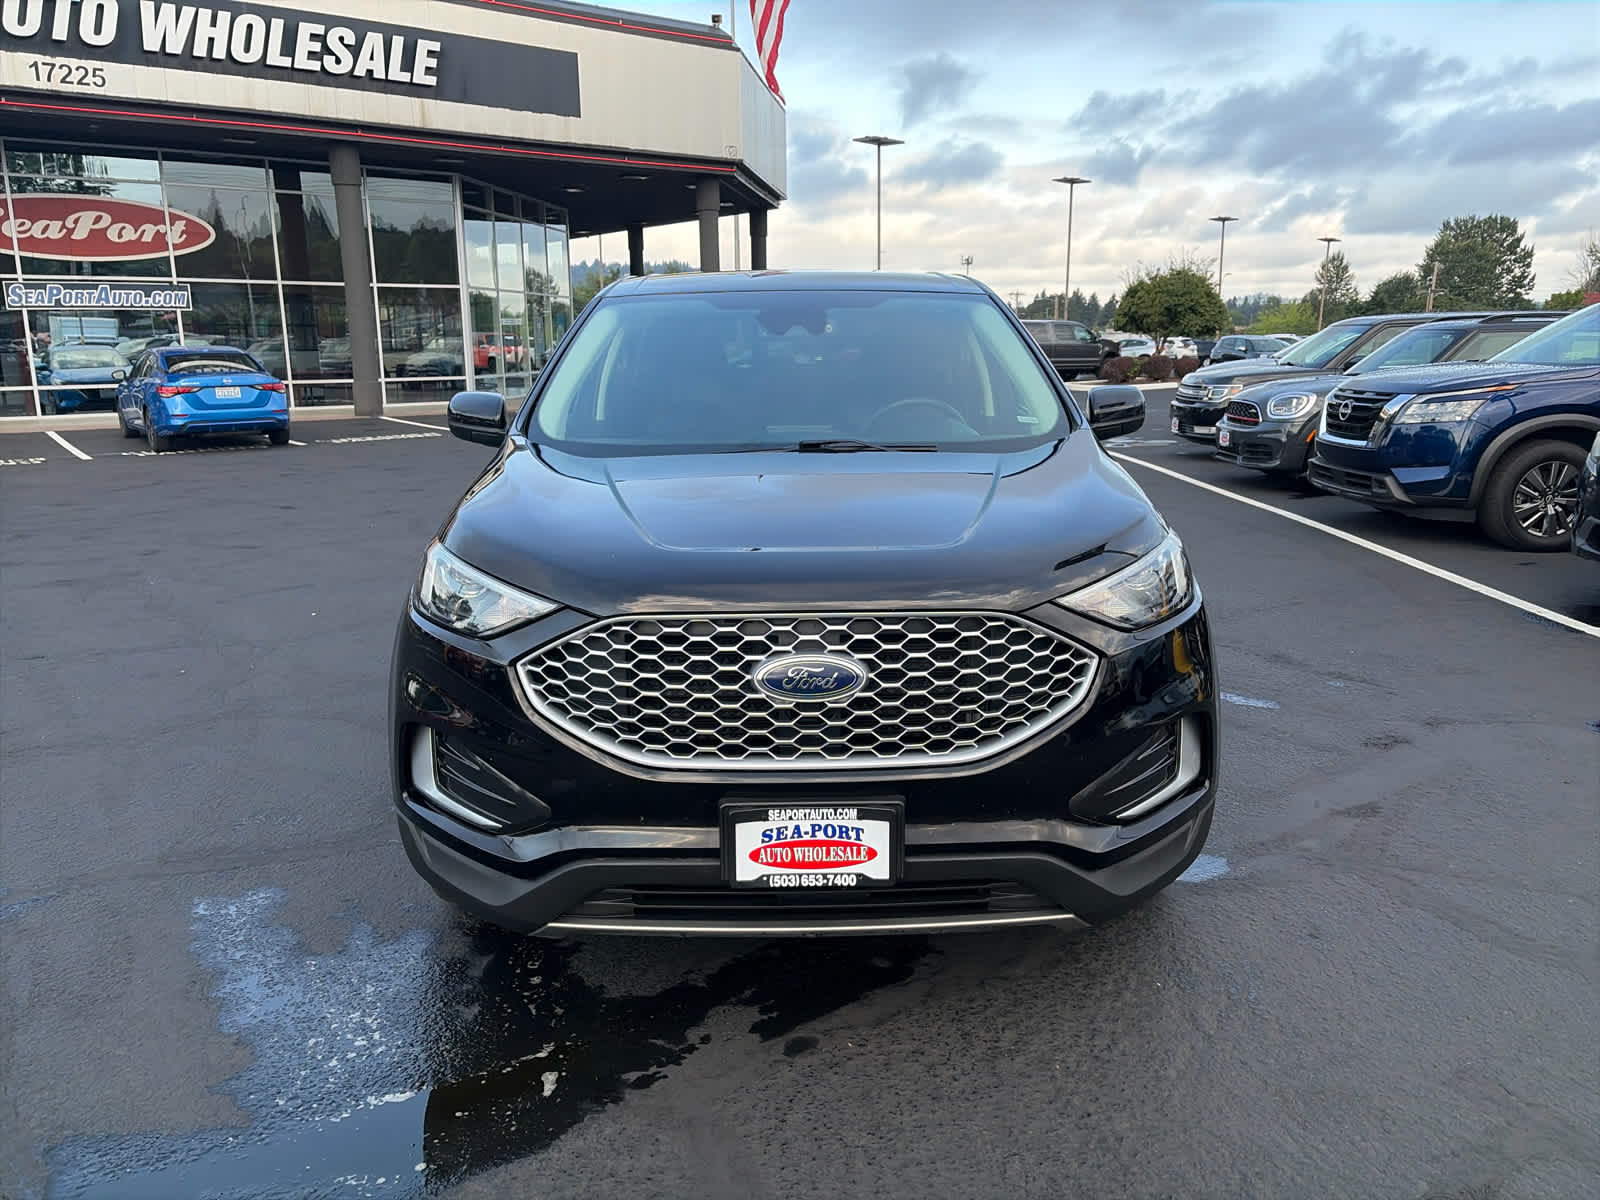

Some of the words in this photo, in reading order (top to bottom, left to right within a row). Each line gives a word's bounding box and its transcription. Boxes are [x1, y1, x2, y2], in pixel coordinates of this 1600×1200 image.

[138, 0, 441, 87] WHOLESALE
[28, 60, 107, 88] 17225
[0, 207, 187, 244] eaPort
[782, 666, 839, 689] Ford
[768, 808, 858, 821] SEAPORTAUTO.COM
[761, 823, 865, 844] SEA-PORT
[758, 847, 791, 863] AUTO
[793, 846, 868, 863] WHOLESALE
[769, 874, 800, 888] (503)
[801, 874, 857, 887] 653-7400
